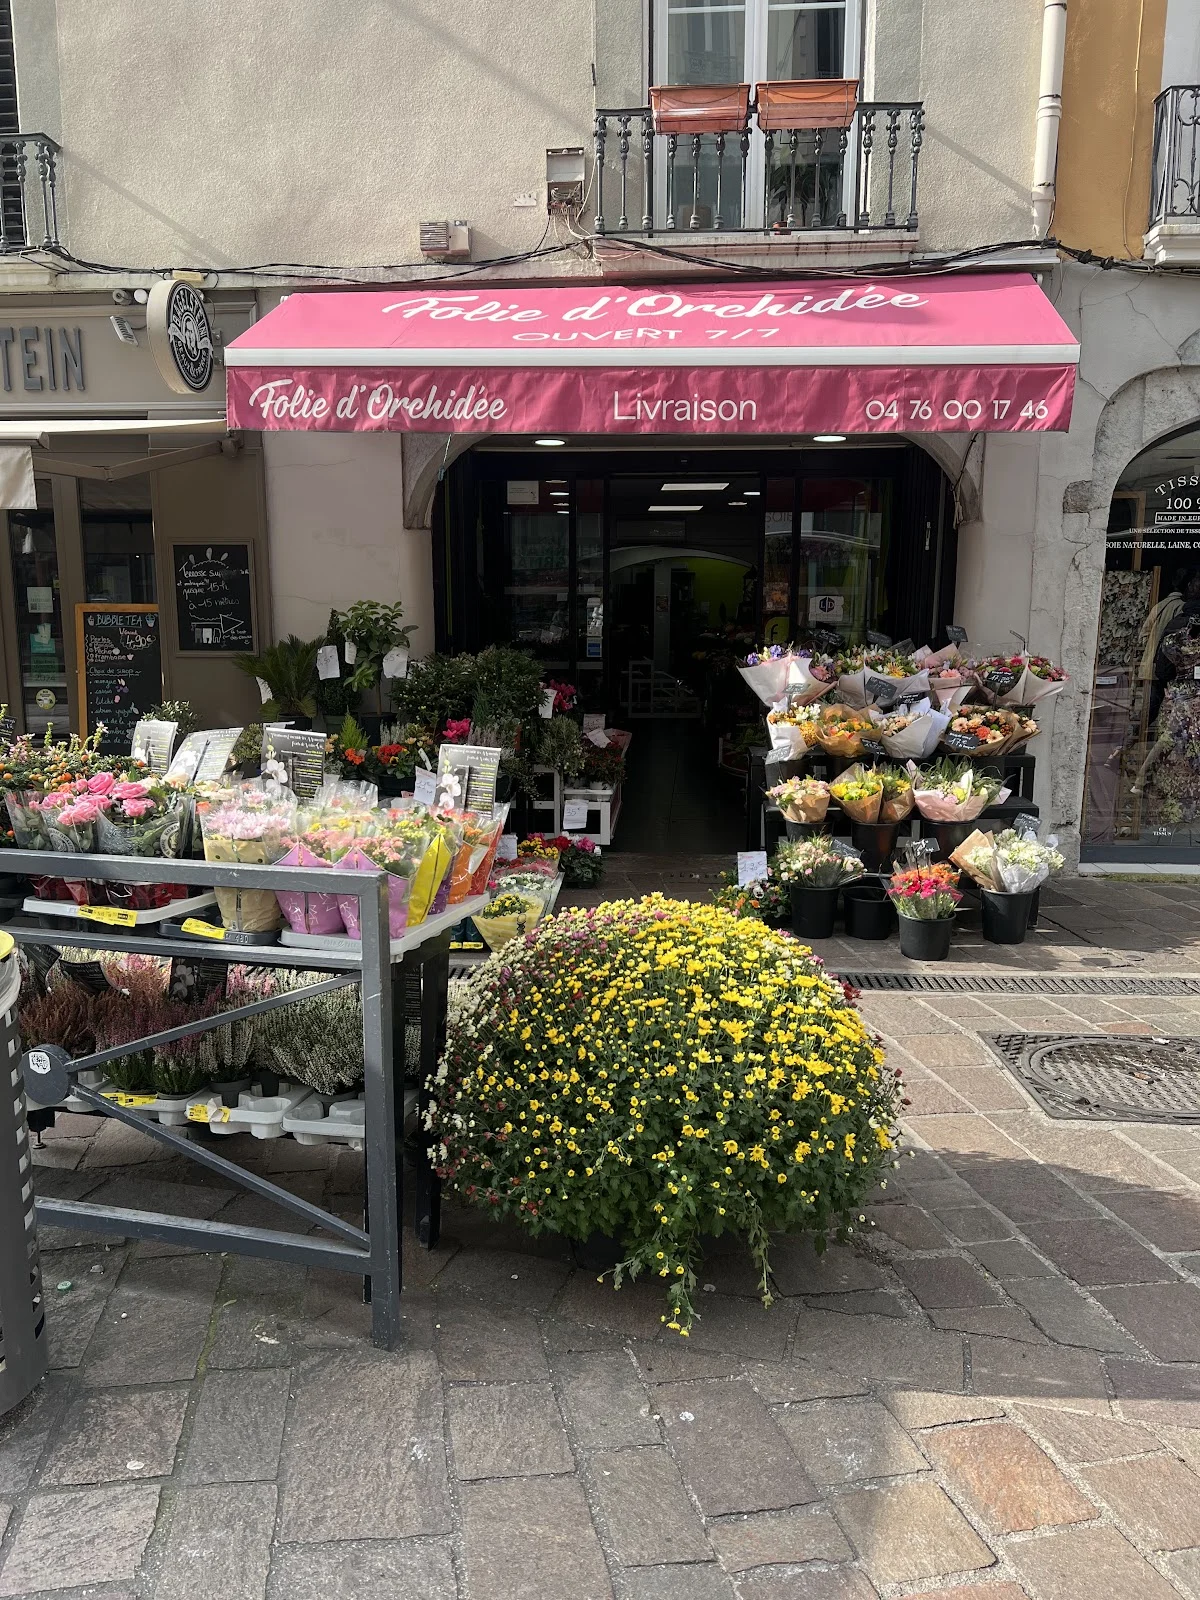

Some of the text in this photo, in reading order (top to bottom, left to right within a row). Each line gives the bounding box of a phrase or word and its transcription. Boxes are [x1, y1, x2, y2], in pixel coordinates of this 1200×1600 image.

[381, 285, 929, 322] Folie d'Orchidée
[512, 327, 780, 341] OUVERT 7/7
[248, 378, 1049, 421] Folie d'Orchidée Livraison 04 76 00 17 46
[1166, 498, 1192, 509] 100
[96, 614, 143, 627] BUBBLE TEA
